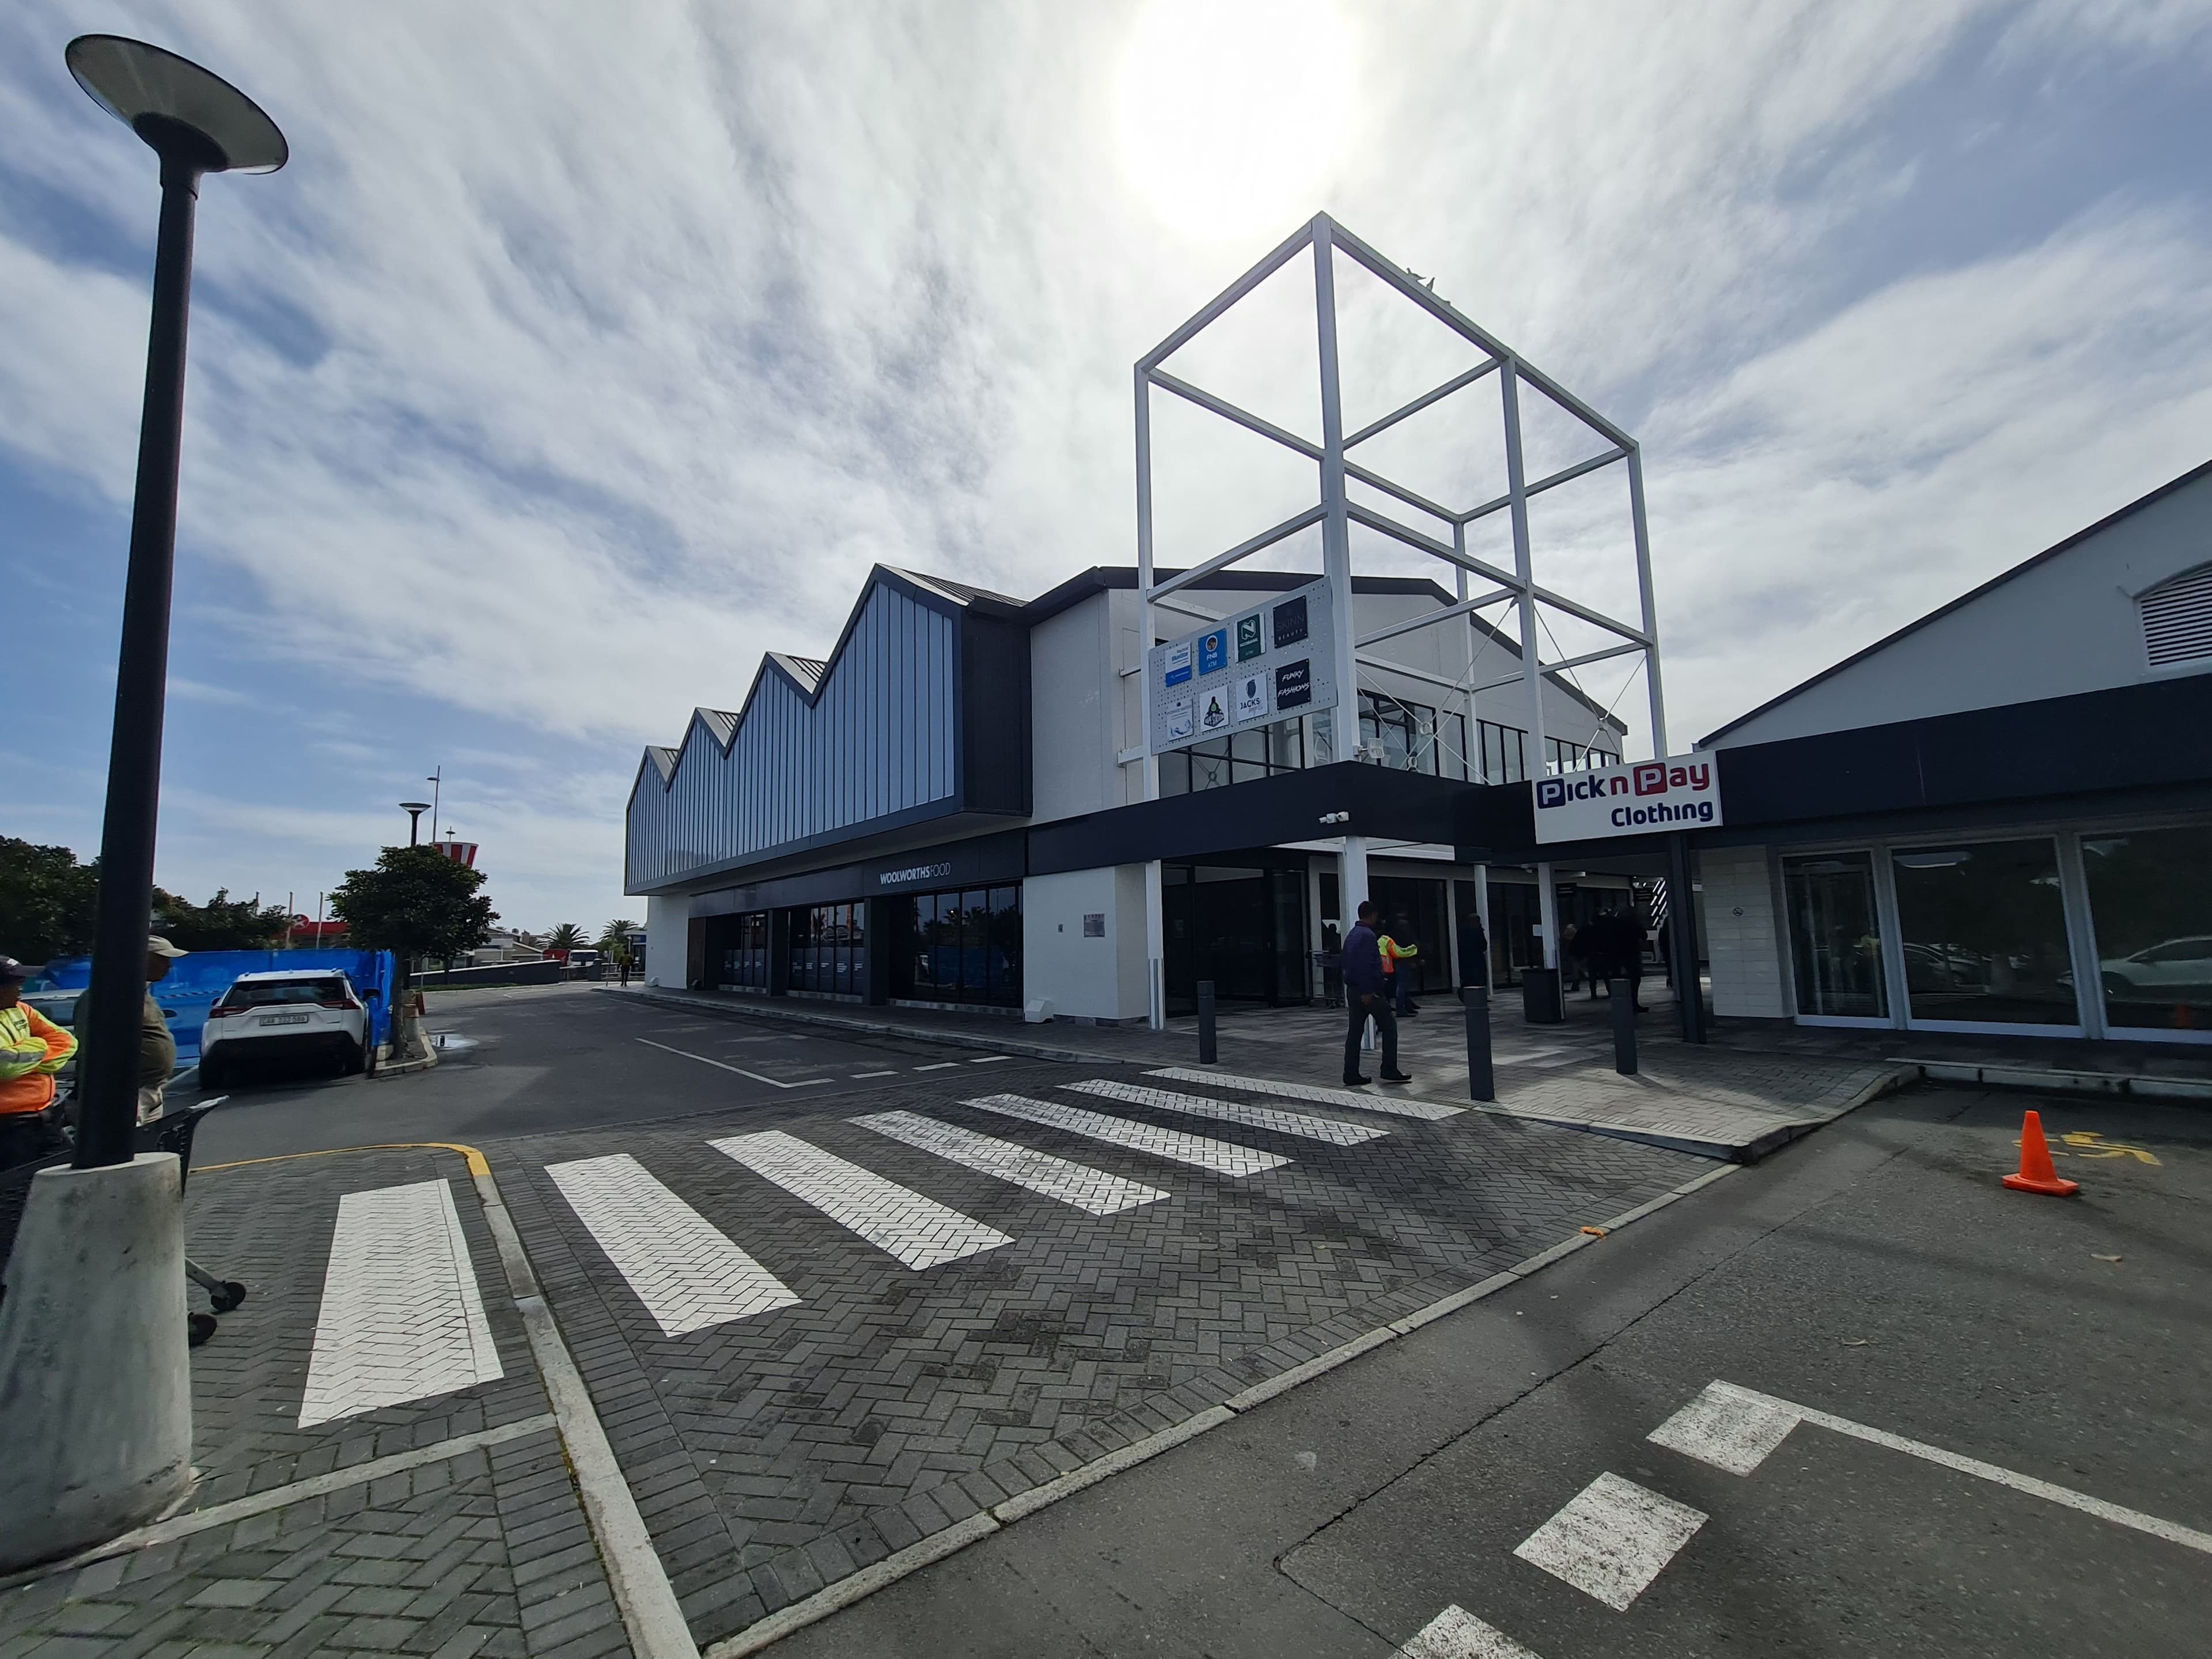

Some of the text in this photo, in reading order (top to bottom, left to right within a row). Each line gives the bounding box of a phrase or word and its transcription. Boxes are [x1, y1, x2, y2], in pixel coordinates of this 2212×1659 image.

[1207, 652, 1217, 661] FNB
[1208, 660, 1217, 668] ATM
[1282, 669, 1304, 682] FUNKY
[1278, 682, 1309, 698] FASHIONS
[1240, 697, 1260, 710] JACKS
[1536, 763, 1710, 809] Pick n Pay
[1611, 801, 1713, 827] Clothing
